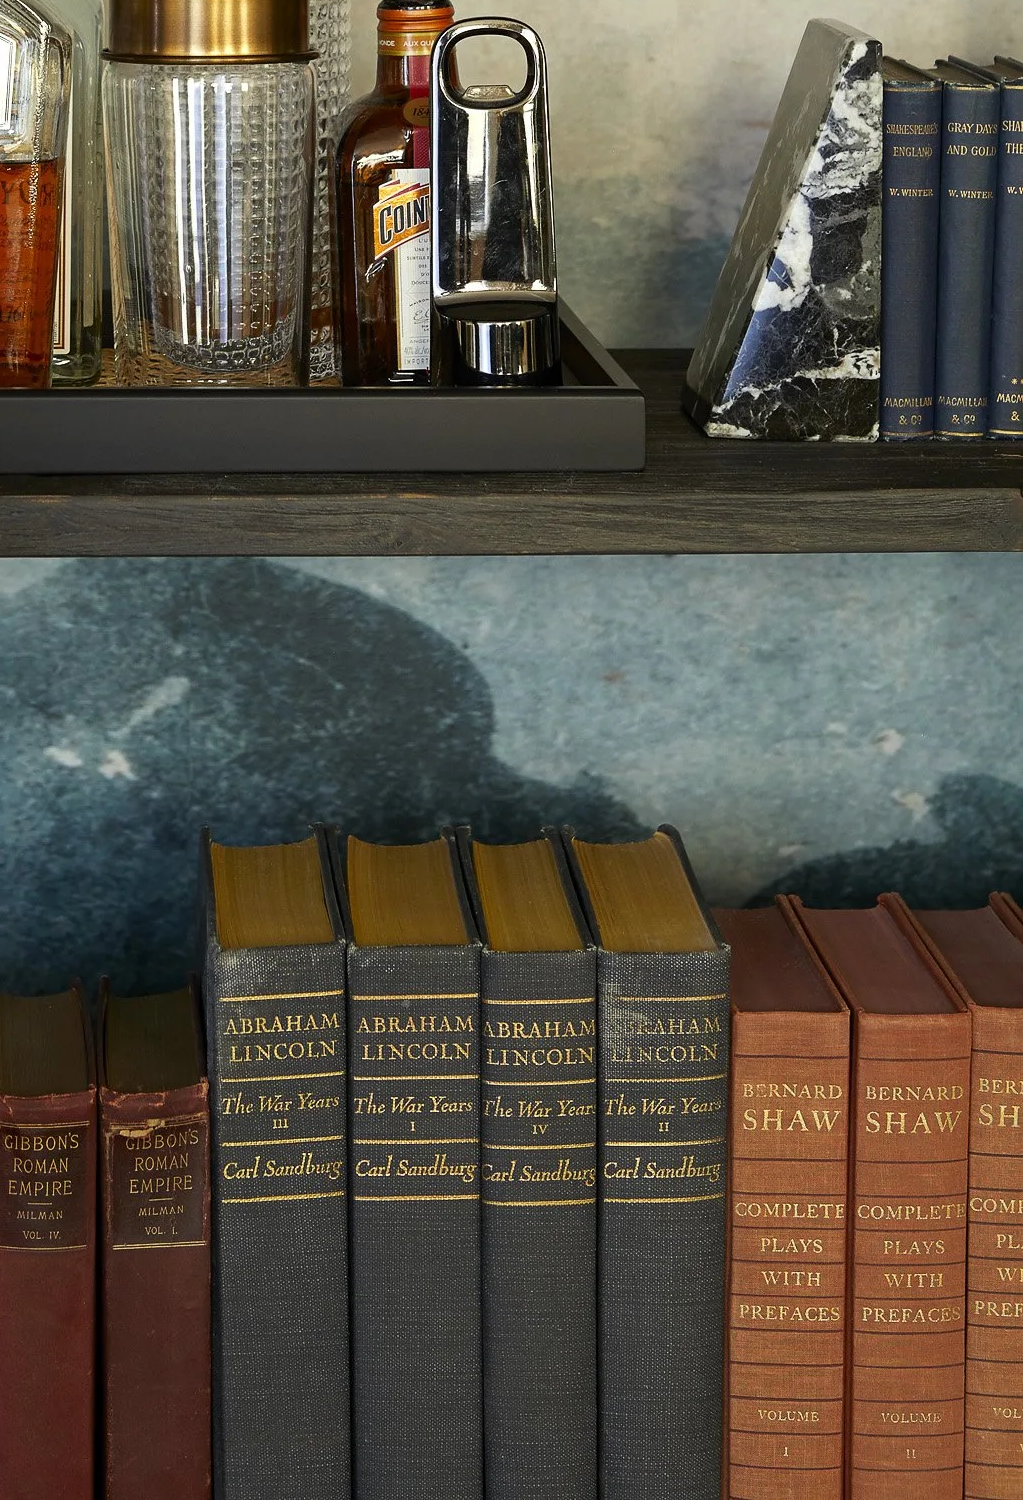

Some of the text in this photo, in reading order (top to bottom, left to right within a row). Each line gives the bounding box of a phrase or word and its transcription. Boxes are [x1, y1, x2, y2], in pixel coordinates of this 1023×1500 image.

[886, 122, 939, 135] SHAKESPEARE'S
[947, 122, 998, 135] GRAY DAYS
[893, 146, 933, 158] ENGLAND
[946, 144, 997, 157] AND GOLD
[889, 187, 934, 198] W. WINTER
[884, 396, 933, 408] MACMILLAN
[223, 1013, 341, 1035] ABRAHAM
[355, 1015, 475, 1033] ABRAHAM
[484, 1019, 595, 1039] ABRAHAM
[230, 1040, 338, 1063] LINCOLN
[361, 1042, 472, 1061] LINCOLN
[486, 1047, 594, 1066] LINCOLN
[611, 1044, 718, 1062] LINCOLN
[742, 1083, 843, 1100] BERNARD
[865, 1084, 964, 1101] BERNARD
[222, 1092, 340, 1115] The War Years
[354, 1093, 473, 1114] The War Years
[605, 1094, 722, 1116] The War Years
[272, 1118, 289, 1130] III
[742, 1108, 842, 1132] SHAW
[865, 1110, 962, 1135] SHAW
[531, 1124, 550, 1135] IV
[4, 1132, 79, 1152] GIBBON'S
[12, 1157, 69, 1174] ROMAN
[134, 1153, 189, 1172] ROMAN
[223, 1152, 344, 1180] Carl Sandburg
[355, 1154, 477, 1183] Carl Sandburg
[604, 1155, 722, 1182] Carl Sandburg
[482, 1158, 596, 1186] Carl Sandburg
[8, 1179, 73, 1196] EMPIRE
[129, 1175, 193, 1194] EMPIRE
[735, 1202, 844, 1219] COMPLETE
[857, 1202, 966, 1220] COMPLETE
[760, 1237, 823, 1254] PLAYS
[883, 1240, 945, 1255] PLAYS
[761, 1270, 821, 1287] WITH
[883, 1272, 944, 1288] WITH
[738, 1303, 841, 1322] PREFACES
[862, 1305, 961, 1324] PREFACES
[757, 1409, 820, 1422] VOLUME
[881, 1412, 942, 1424] VOLUME
